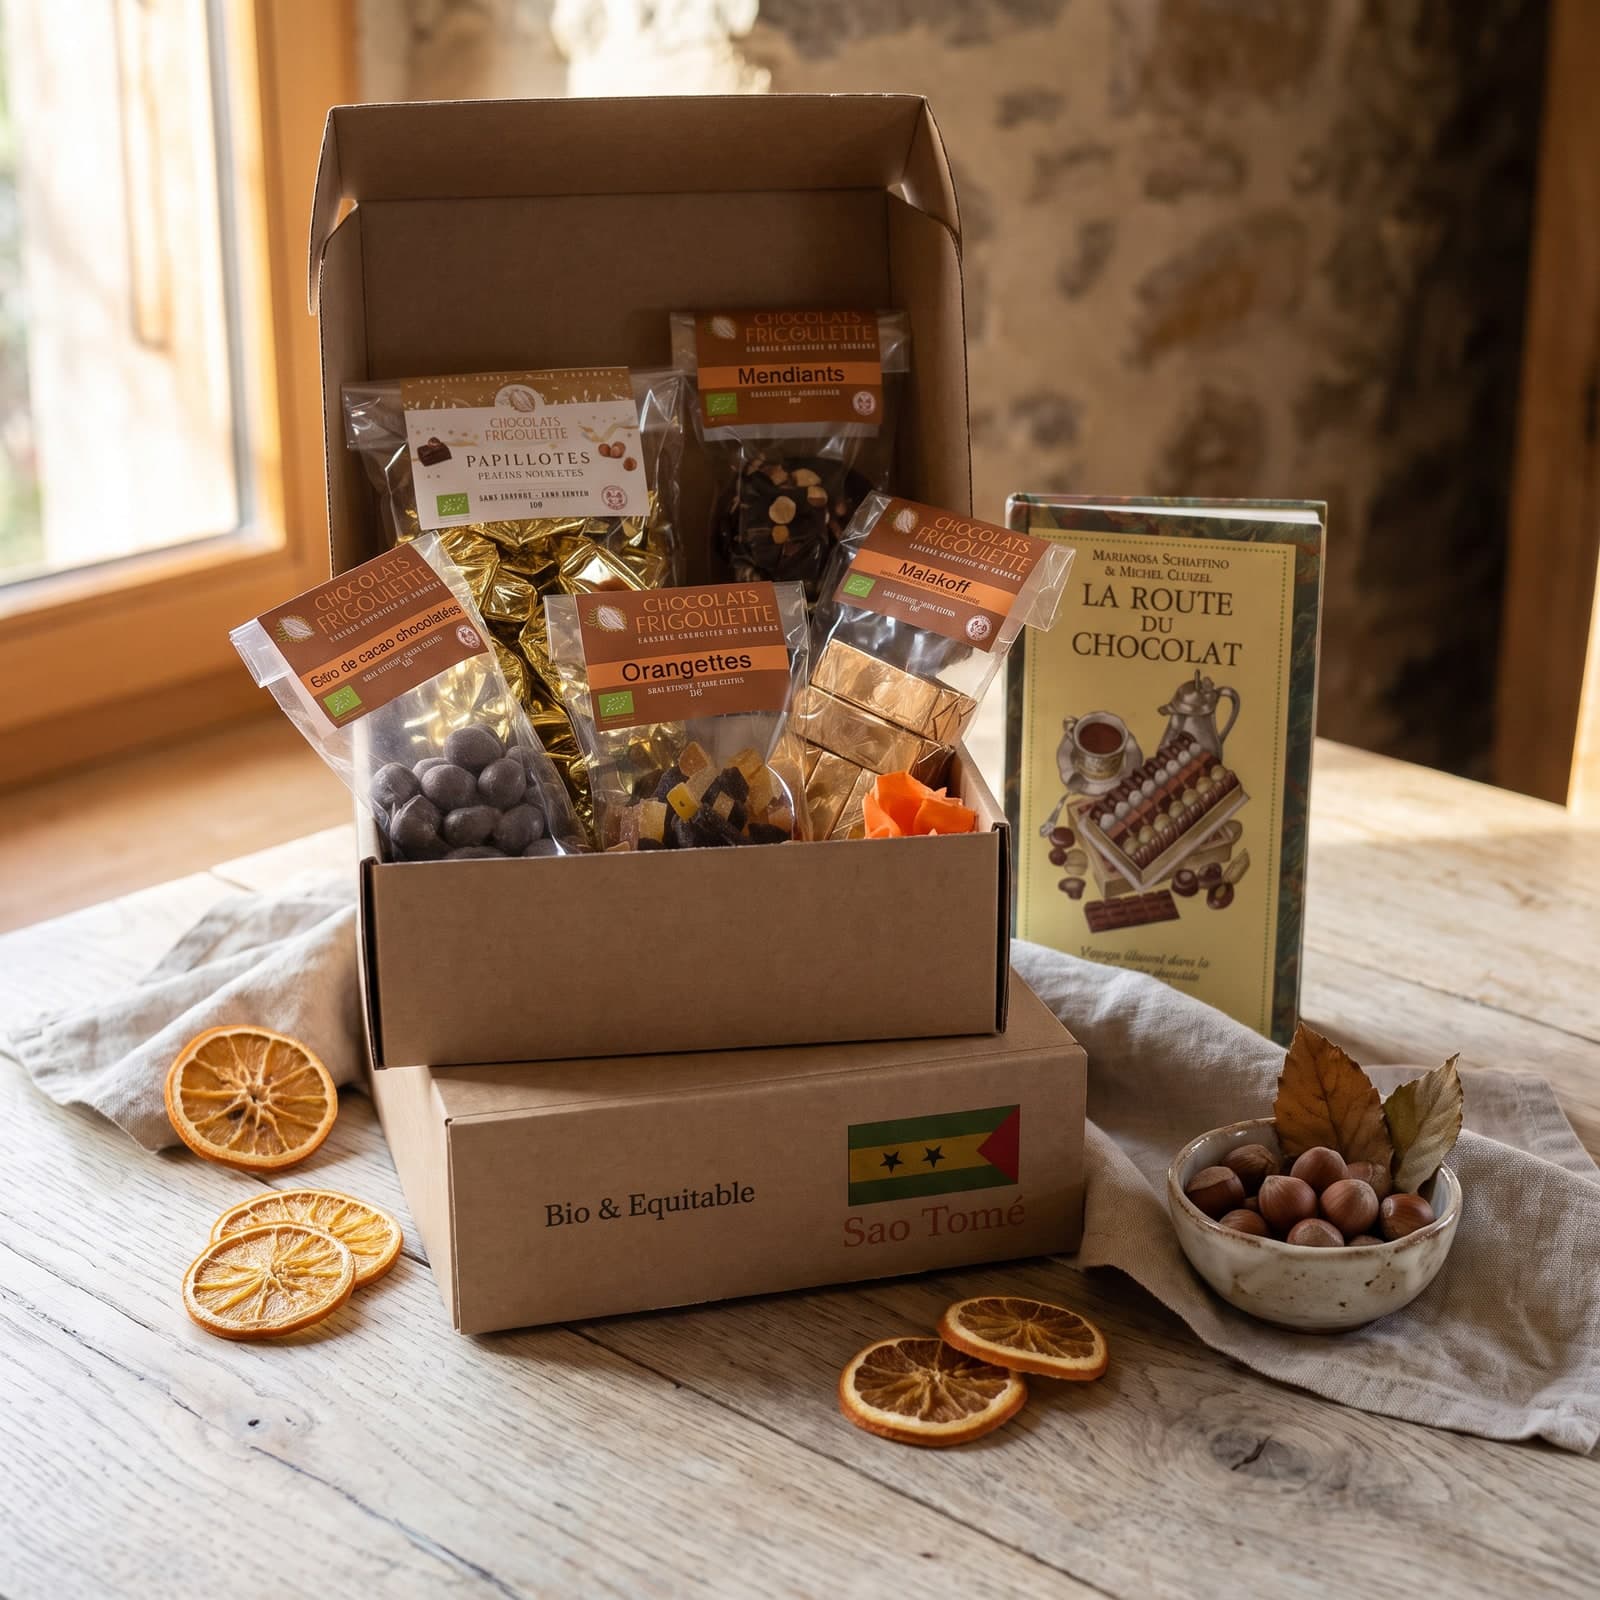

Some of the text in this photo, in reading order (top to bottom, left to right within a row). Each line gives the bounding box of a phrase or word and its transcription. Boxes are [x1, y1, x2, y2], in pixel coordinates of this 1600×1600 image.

[754, 312, 862, 326] CHOCOLATS
[738, 366, 845, 385] Mendiants
[485, 427, 569, 441] FRIGOULETTE
[490, 416, 561, 428] CHOCOLATS
[466, 451, 591, 468] PAPILLOTES
[915, 526, 1033, 574] FRIGOULETTE
[935, 516, 1033, 554] CHOCOLATS
[315, 556, 411, 611] CHOCOLATS
[898, 562, 972, 594] Malakoff
[1105, 566, 1115, 577] &
[317, 565, 434, 634] FRIGOULETTE
[643, 589, 759, 613] CHOCOLATS
[1082, 583, 1233, 616] LA ROUTE
[636, 604, 776, 634] FRIGOULETTE
[1141, 615, 1173, 633] DU
[341, 660, 358, 678] de
[358, 637, 396, 664] cacao
[396, 604, 462, 642] chocolatées
[1072, 632, 1243, 666] CHOCOLAT
[622, 654, 752, 682] Orangettes
[545, 1181, 755, 1227] Bio & Equitable
[842, 1195, 1026, 1248] Sao Tomé
